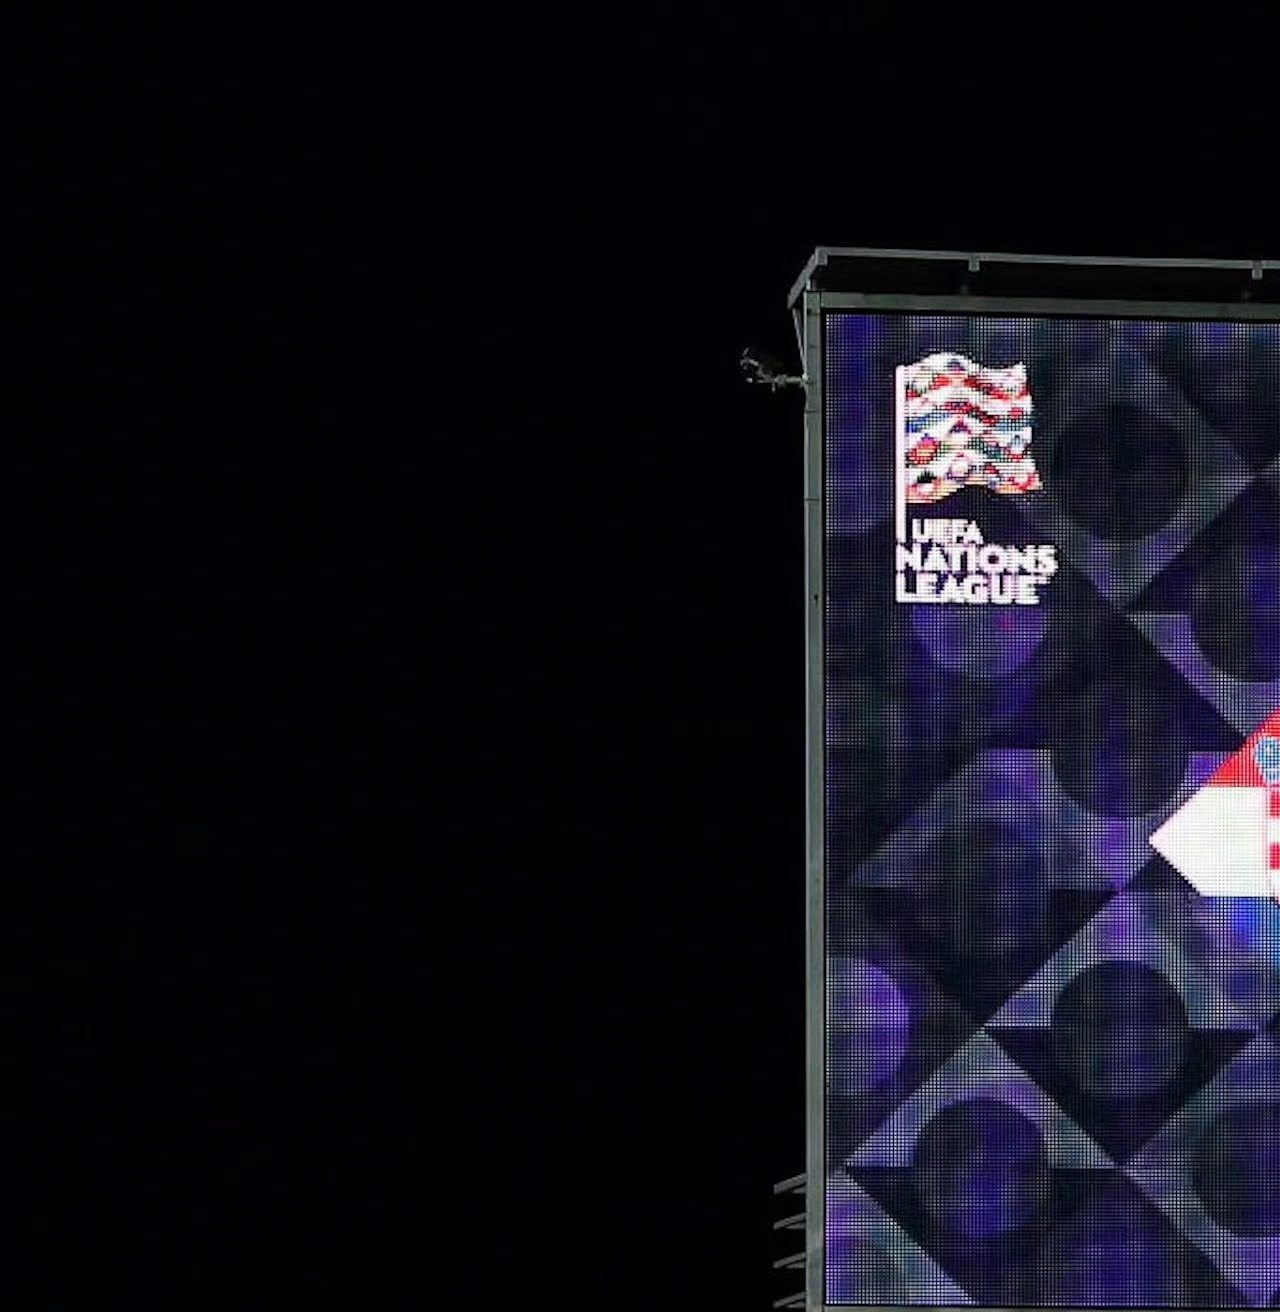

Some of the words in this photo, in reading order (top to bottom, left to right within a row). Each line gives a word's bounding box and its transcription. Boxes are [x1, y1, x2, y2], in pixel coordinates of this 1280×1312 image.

[912, 518, 984, 544] UEFA
[896, 545, 1058, 573] NATIONS
[896, 572, 1051, 604] LEAGUE
